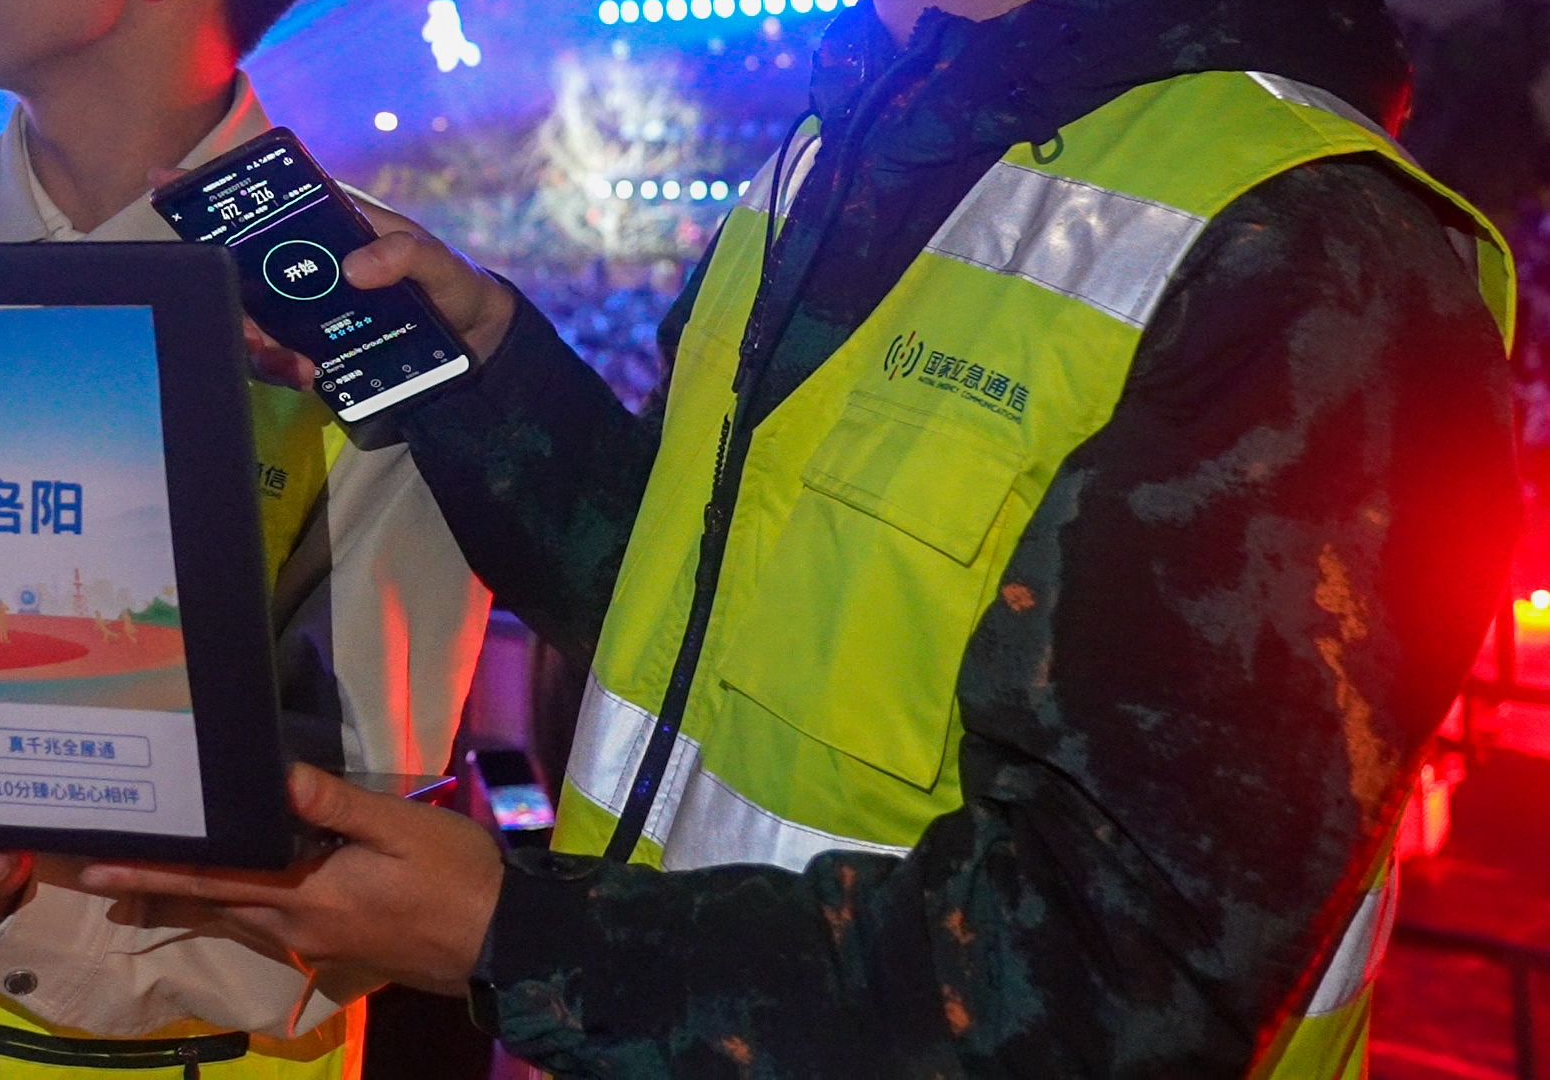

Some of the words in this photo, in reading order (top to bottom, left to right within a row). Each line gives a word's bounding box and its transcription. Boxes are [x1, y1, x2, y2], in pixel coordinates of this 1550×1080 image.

[251, 186, 274, 204] 216
[220, 203, 242, 220] 472
[283, 259, 319, 282] 开始
[8, 734, 116, 760] 真千兆全屋通
